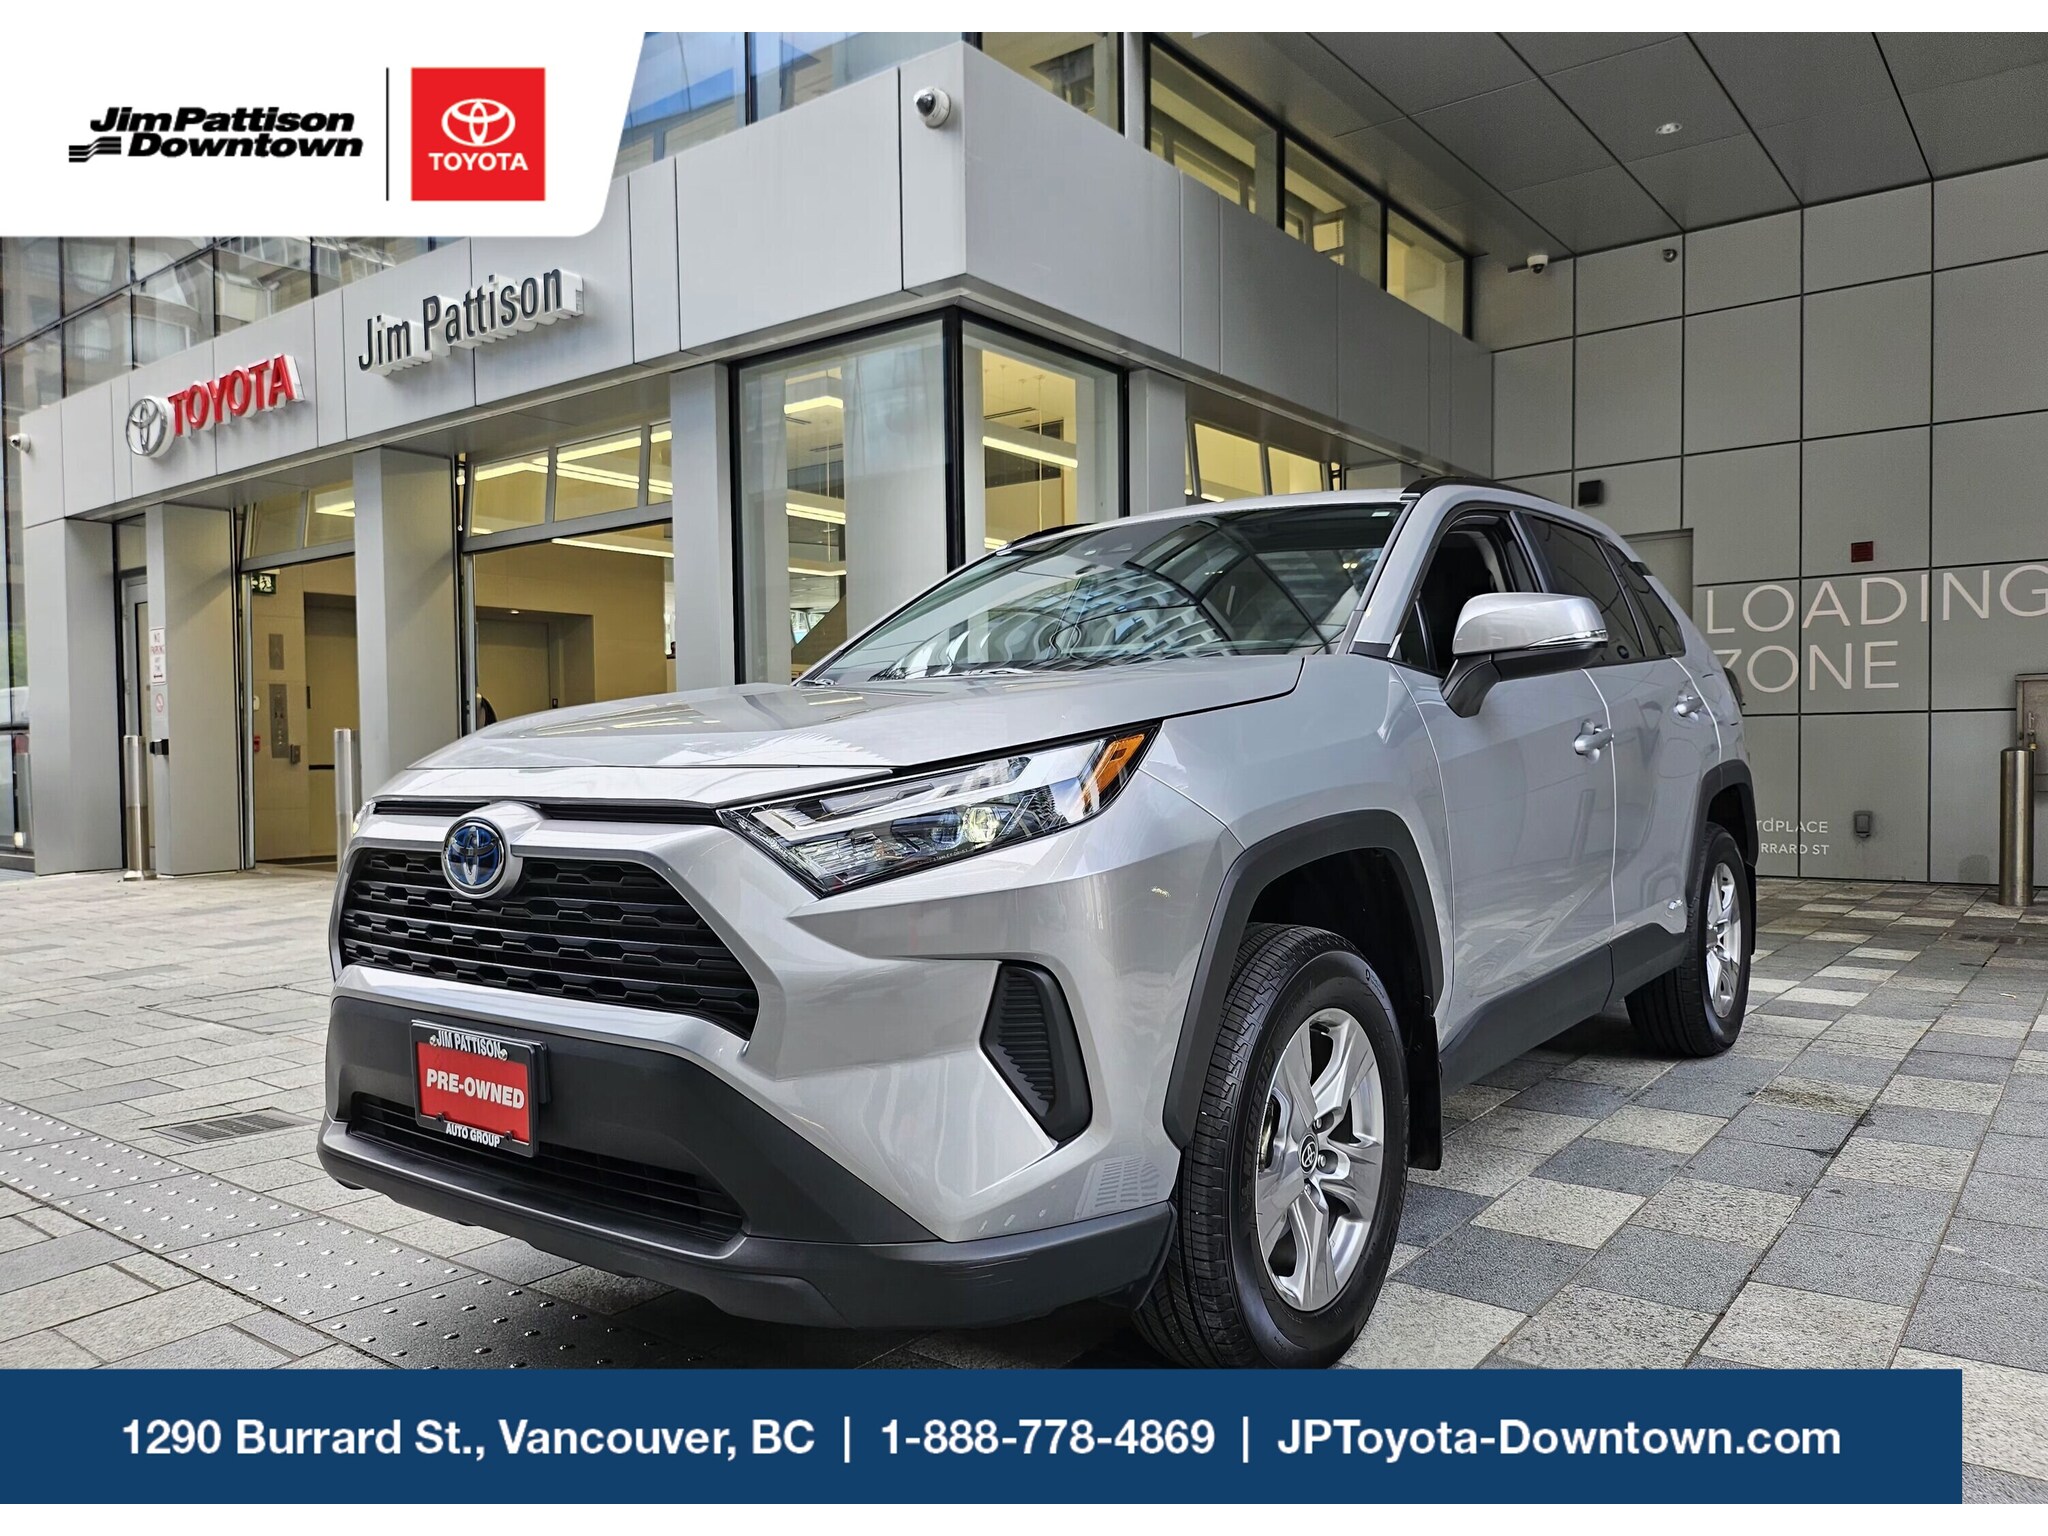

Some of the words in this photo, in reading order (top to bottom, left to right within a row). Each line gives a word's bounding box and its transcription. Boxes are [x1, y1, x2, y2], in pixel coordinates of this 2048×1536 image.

[358, 314, 413, 371] Jim
[422, 268, 563, 352] Pattison
[168, 354, 296, 437] TOYOTA
[1706, 564, 2048, 634] LOADING
[1812, 844, 1830, 855] ST
[436, 1029, 452, 1049] JIM
[454, 1033, 501, 1059] PATTISON
[426, 1068, 525, 1109] PRE-OWNED
[445, 1122, 469, 1140] AUTO
[470, 1130, 501, 1148] GROUP
